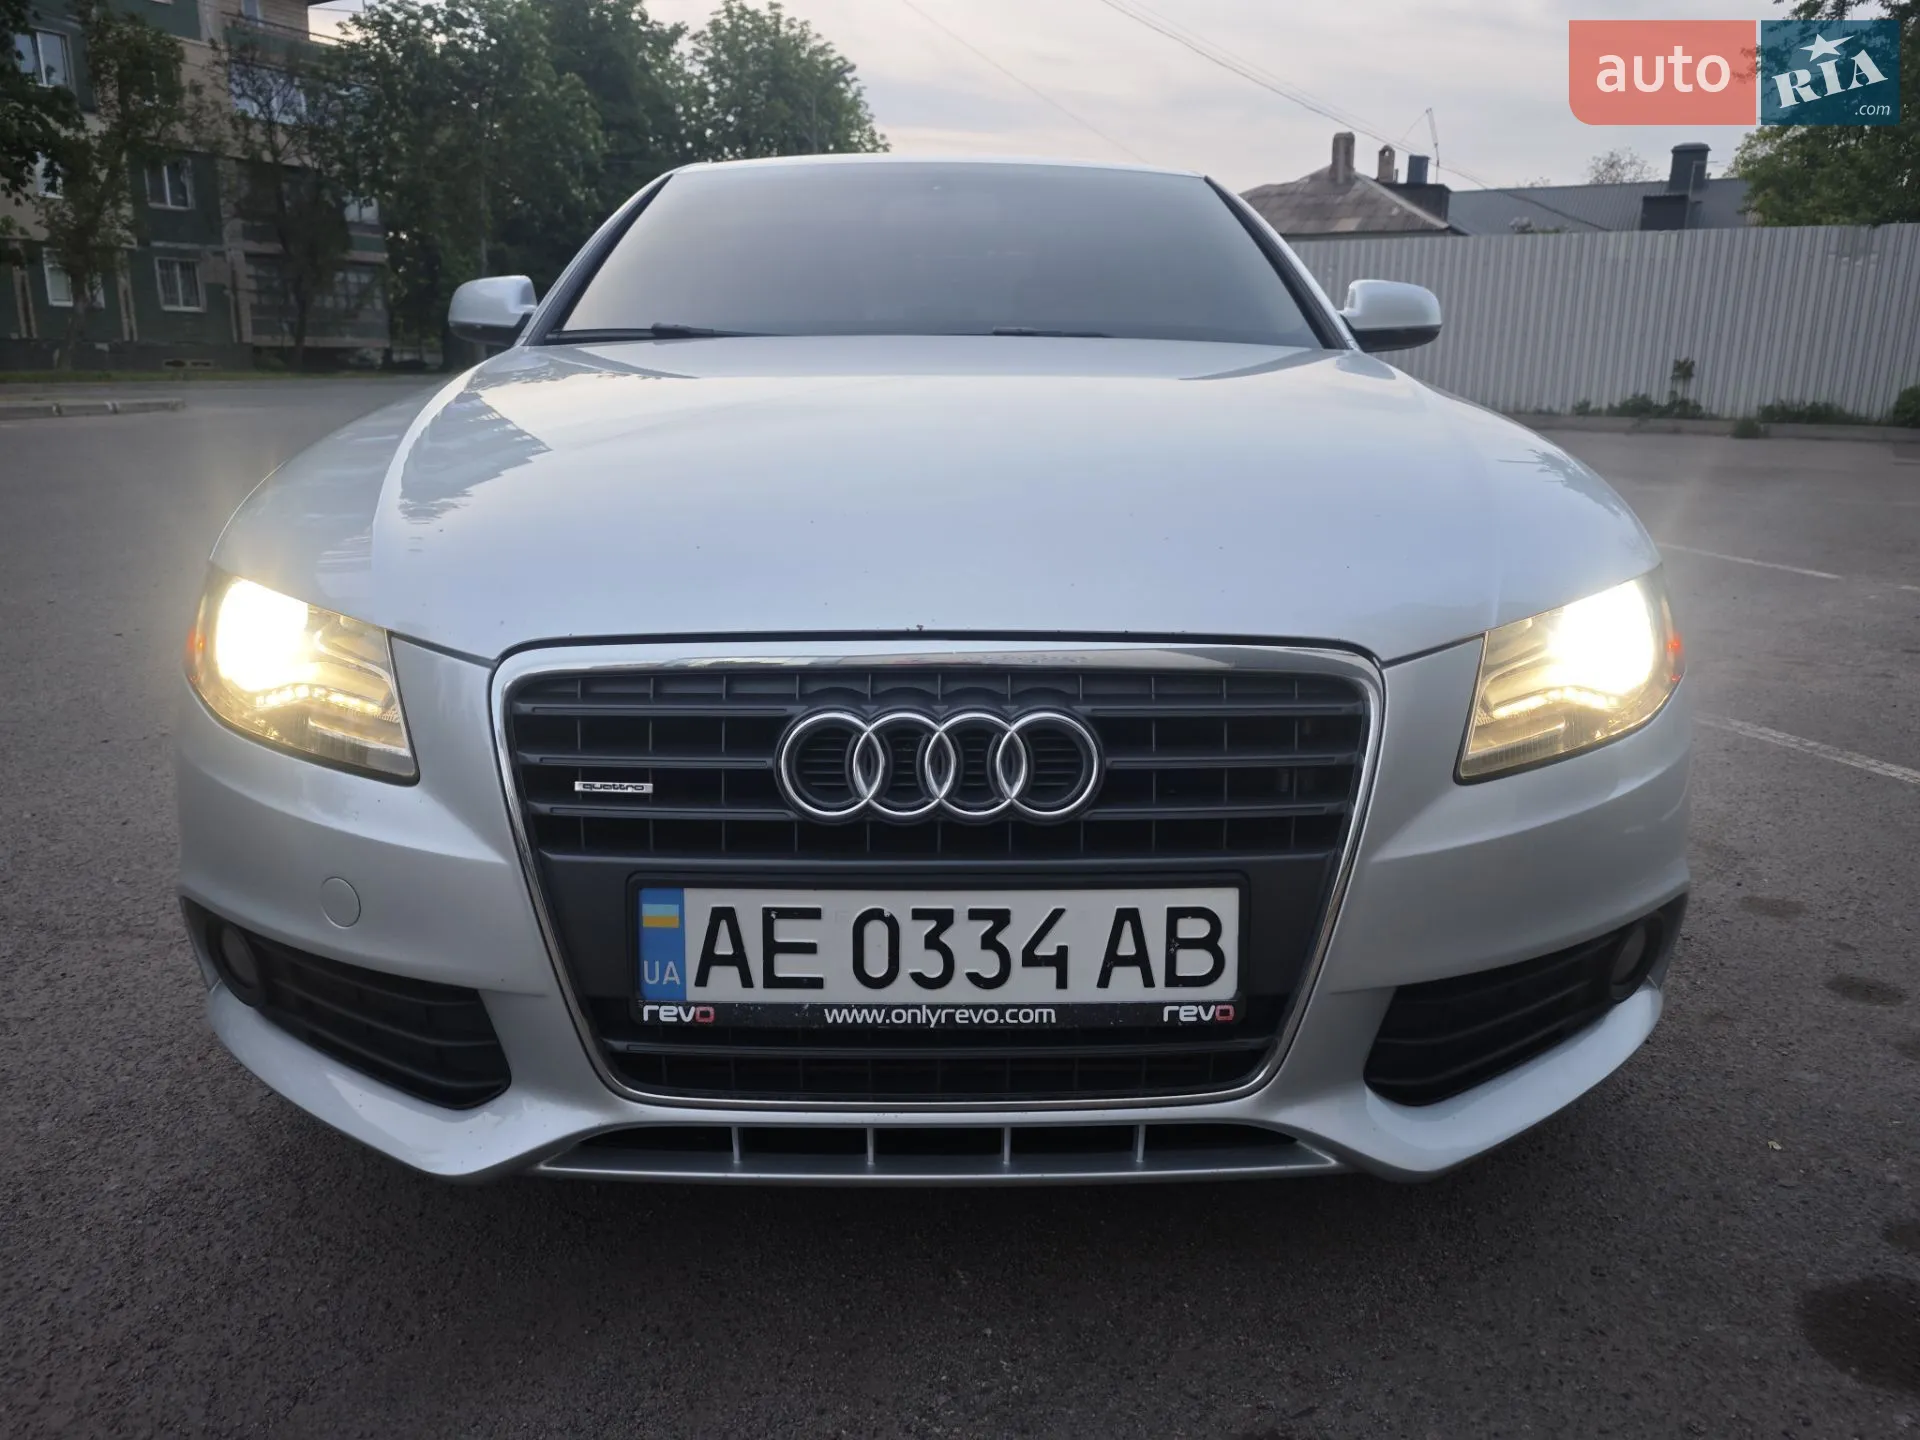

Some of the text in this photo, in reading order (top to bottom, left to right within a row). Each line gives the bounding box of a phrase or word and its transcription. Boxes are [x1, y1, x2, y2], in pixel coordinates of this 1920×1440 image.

[582, 783, 645, 792] quattro
[694, 906, 1226, 990] AE 0334 AB
[643, 960, 681, 985] UA
[642, 1004, 715, 1023] revo
[824, 1005, 1057, 1028] www.onlyrevo.com
[1162, 1004, 1235, 1022] revo
